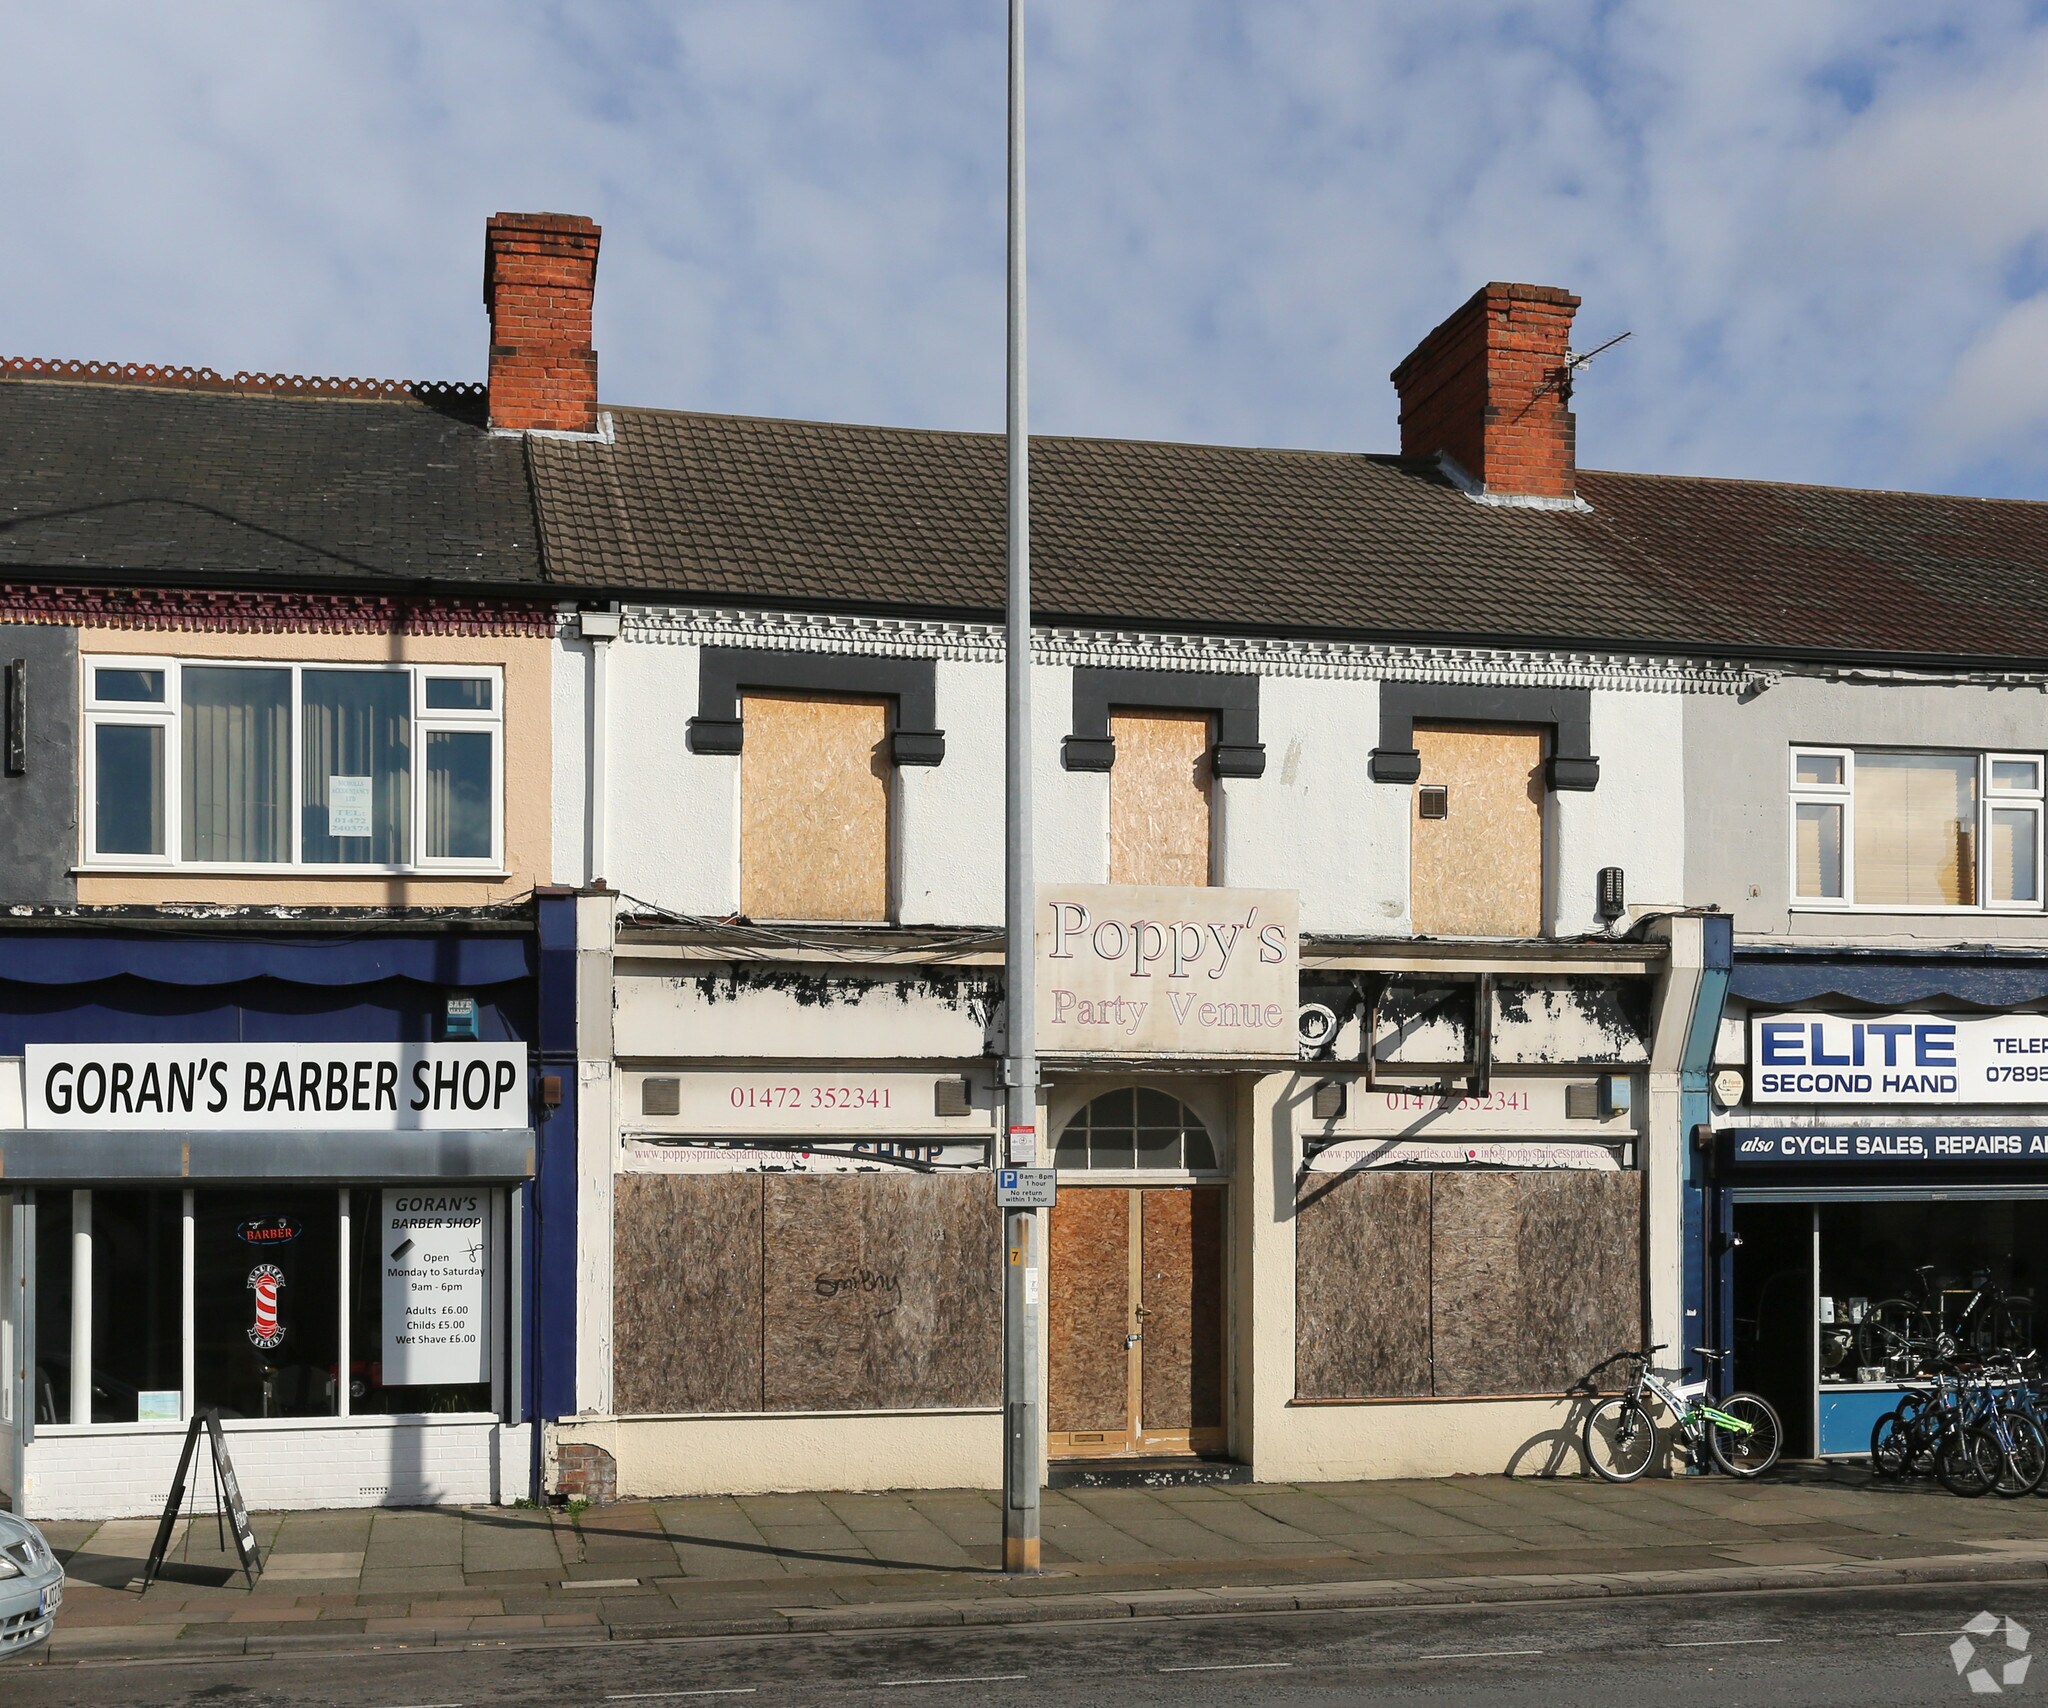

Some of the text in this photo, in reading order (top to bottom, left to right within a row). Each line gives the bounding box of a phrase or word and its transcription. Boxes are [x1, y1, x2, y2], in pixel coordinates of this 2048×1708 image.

[1049, 901, 1287, 979] Poppy's
[1051, 989, 1282, 1035] Party Venue
[1761, 1023, 1957, 1067] ELITE
[45, 1059, 516, 1115] GORAN'S BARBER SHOP
[1761, 1074, 1957, 1093] SECOND HAND
[730, 1087, 892, 1109] 01472 352341
[1320, 1146, 1465, 1161] www.poppysprincessparties.co.uk
[1740, 1136, 2048, 1159] also CYCLE SALES, REPAIRS A
[1004, 1172, 1015, 1187] P
[395, 1196, 478, 1212] GORAN'S
[391, 1217, 481, 1229] BARBER SHOP
[246, 1228, 293, 1240] BARBER
[423, 1254, 450, 1264] Open
[1012, 1252, 1019, 1261] 7
[388, 1267, 485, 1278] Monday to Saturday
[411, 1283, 432, 1291] 9am
[441, 1283, 463, 1293] 6pm
[405, 1306, 469, 1315] Adults £6.00
[407, 1320, 465, 1330] Childs £5.00
[395, 1335, 416, 1344] Wet
[418, 1335, 447, 1344] Shave
